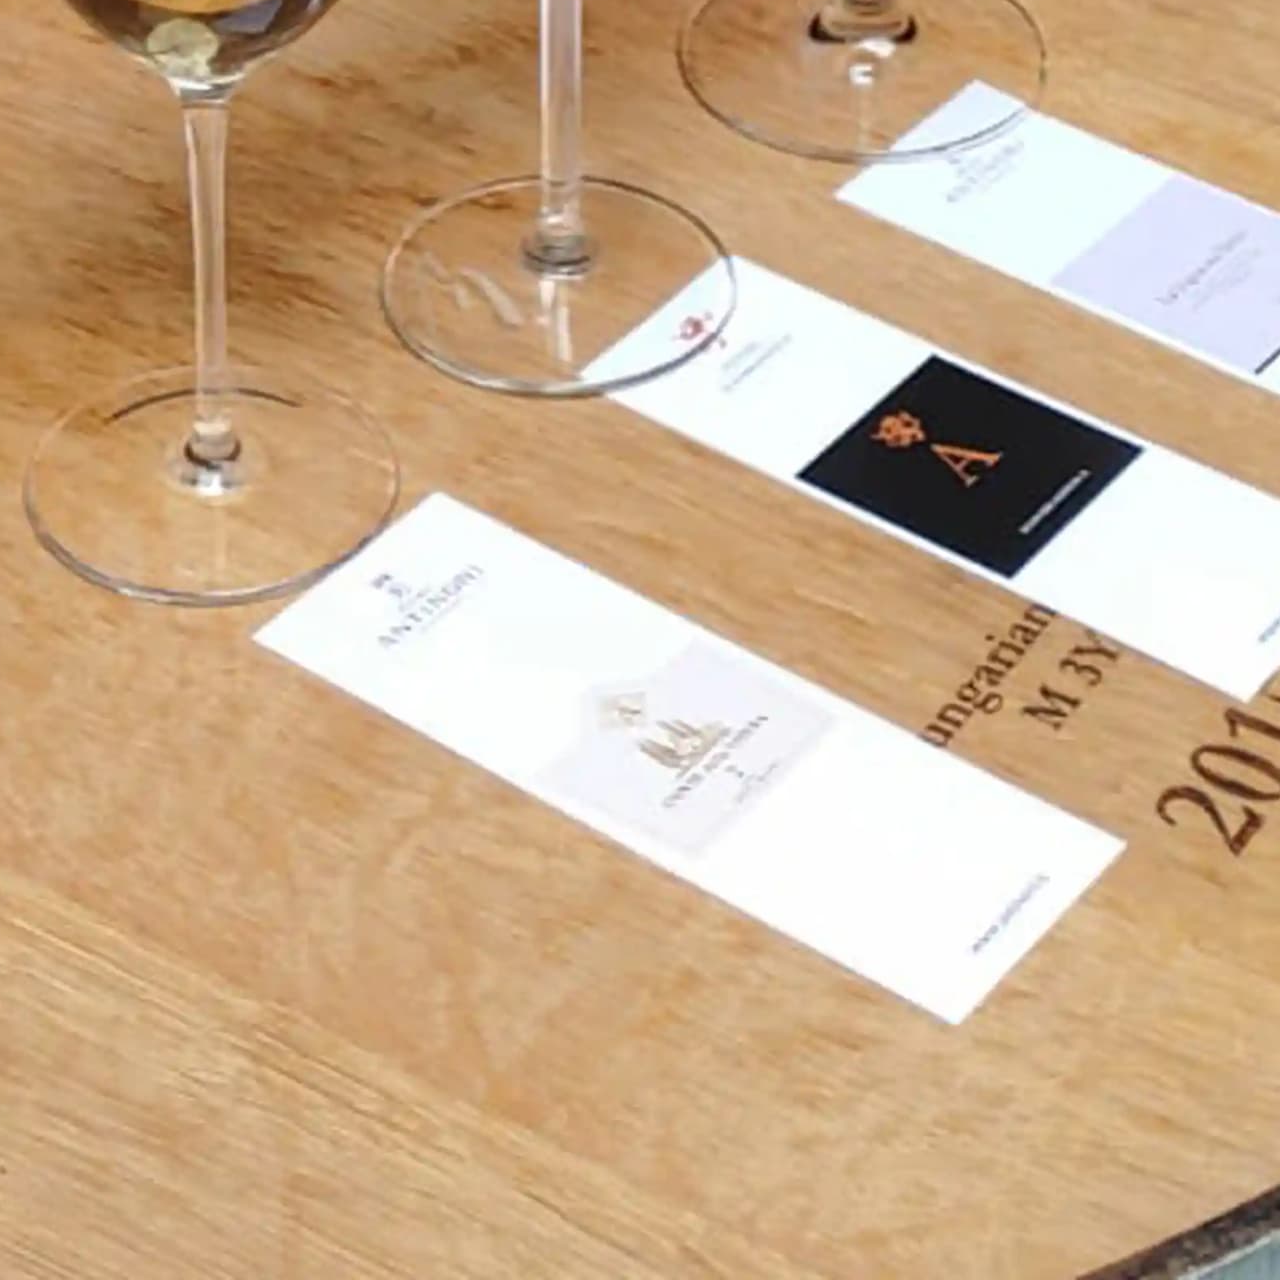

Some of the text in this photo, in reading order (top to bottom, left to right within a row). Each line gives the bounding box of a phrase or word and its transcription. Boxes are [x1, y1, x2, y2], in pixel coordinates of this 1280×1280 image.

[930, 442, 1004, 487] A
[921, 601, 1059, 749] ungarian
[1022, 684, 1082, 732] M
